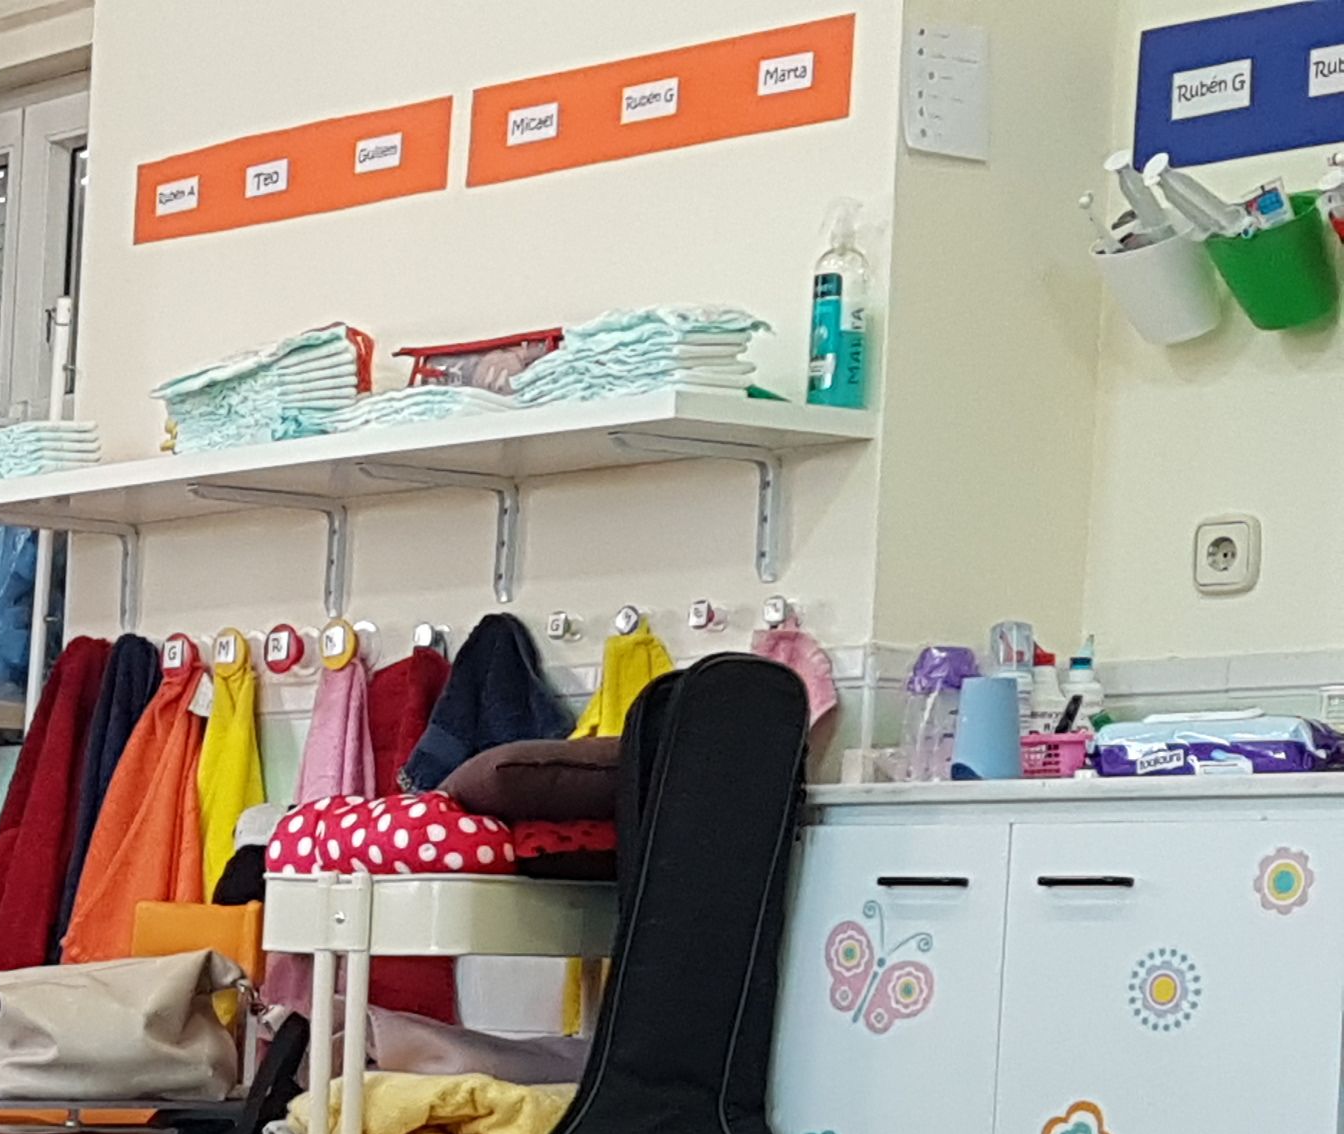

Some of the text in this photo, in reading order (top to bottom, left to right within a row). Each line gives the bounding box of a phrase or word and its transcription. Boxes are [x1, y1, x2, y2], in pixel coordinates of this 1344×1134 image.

[764, 65, 808, 86] Marta
[664, 87, 675, 103] G
[1177, 72, 1246, 103] Rubén G
[550, 618, 561, 632] G
[168, 645, 177, 661] G
[217, 640, 230, 658] M
[271, 637, 283, 653] R
